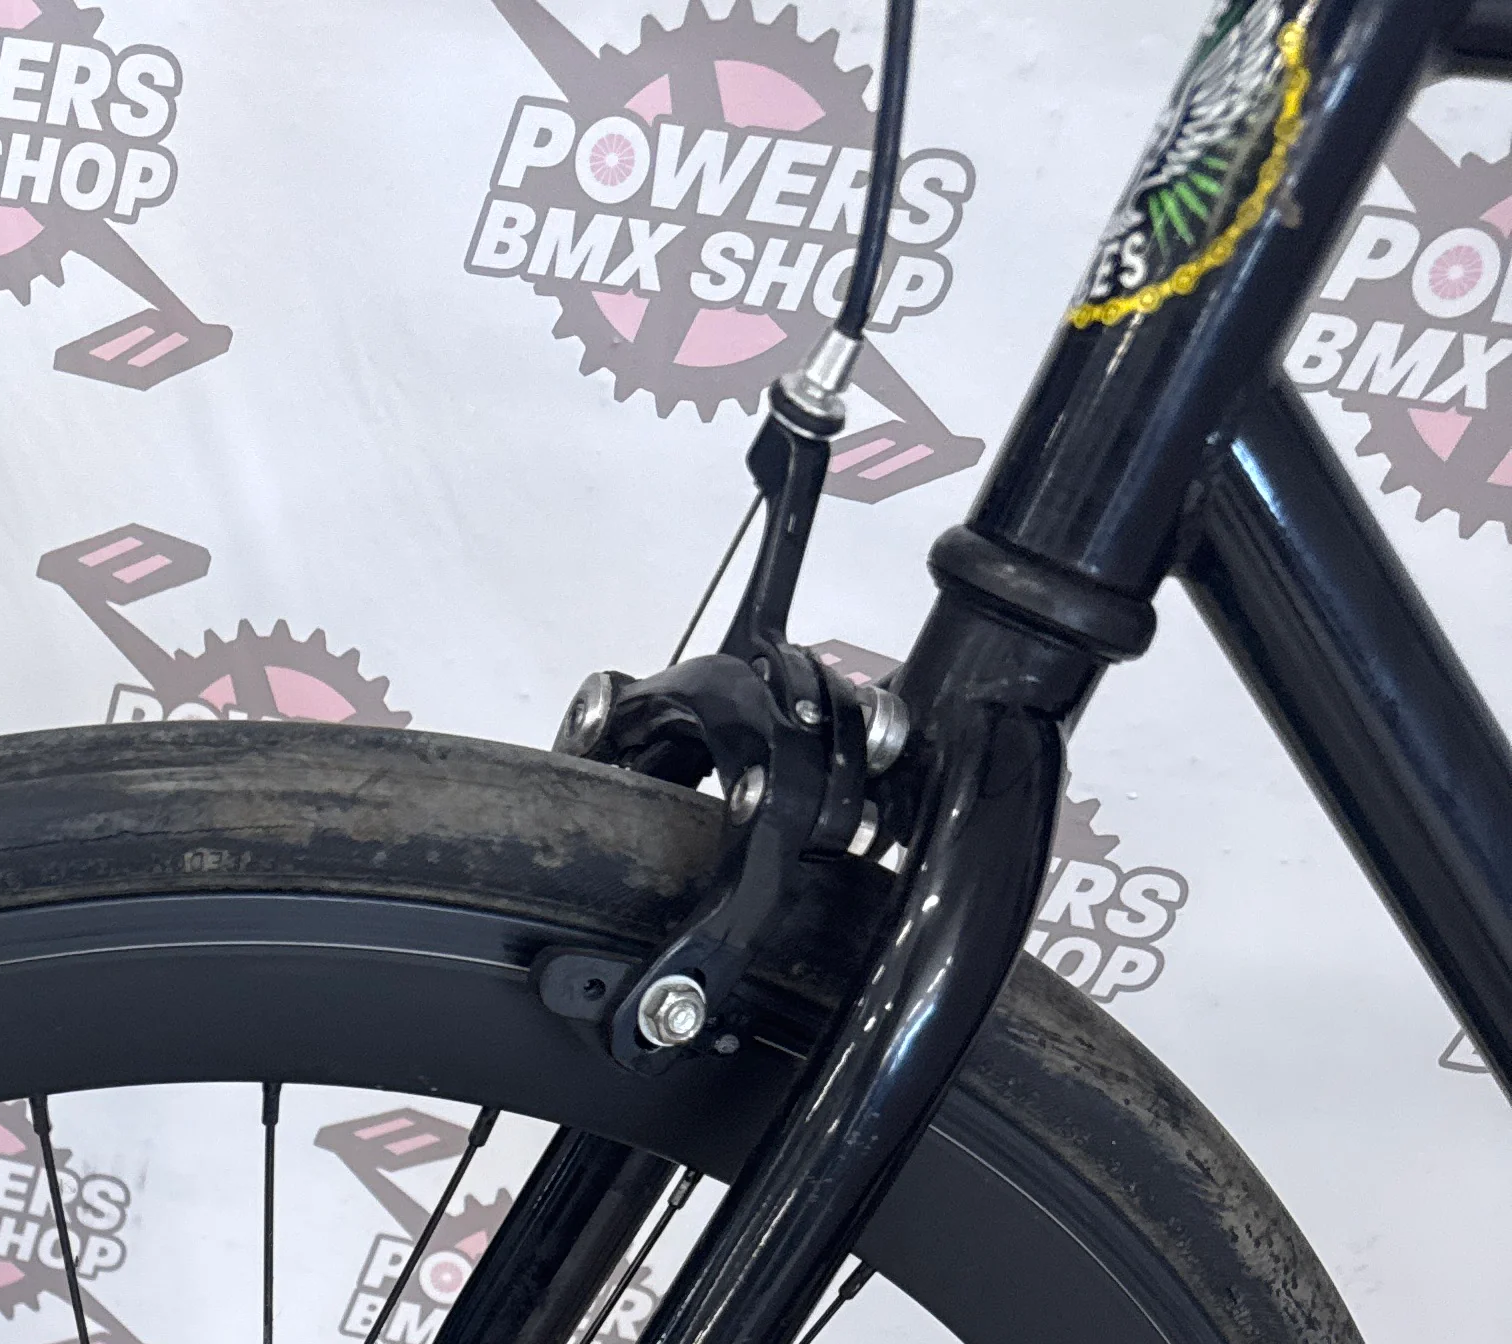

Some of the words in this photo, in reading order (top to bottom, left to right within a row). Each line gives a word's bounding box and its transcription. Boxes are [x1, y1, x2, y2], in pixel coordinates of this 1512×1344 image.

[497, 104, 968, 244] POWERS
[471, 199, 686, 292] BMX
[690, 230, 946, 325] SHOP
[1283, 312, 1512, 410] BMX
